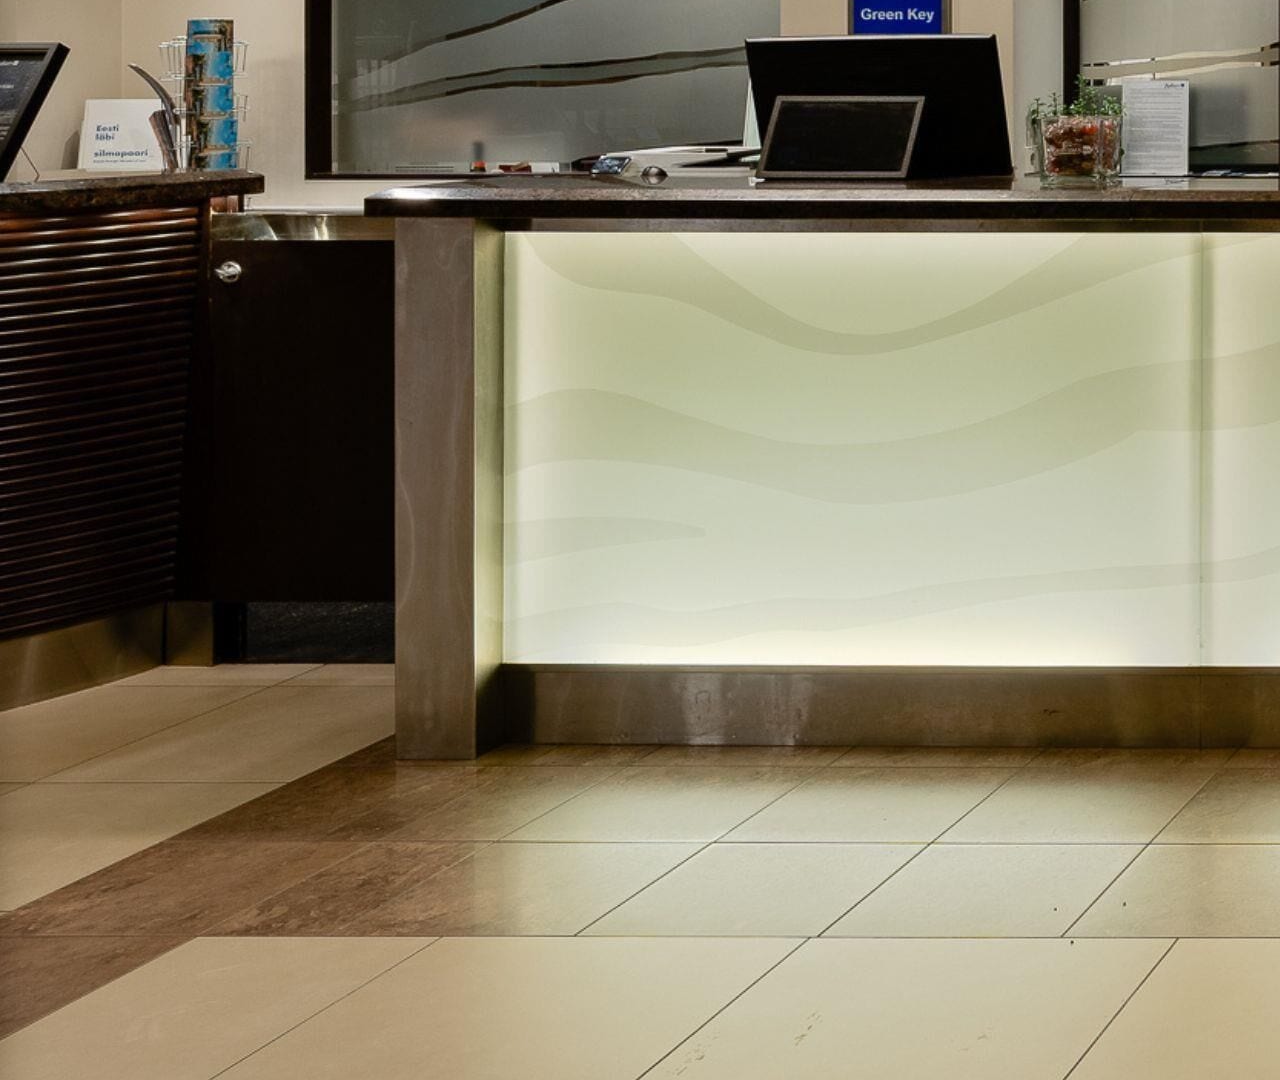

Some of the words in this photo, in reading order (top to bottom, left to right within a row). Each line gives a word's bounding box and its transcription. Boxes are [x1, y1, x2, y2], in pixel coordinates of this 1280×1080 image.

[860, 8, 903, 21] Green
[907, 8, 935, 24] Key
[96, 124, 119, 132] Eesti
